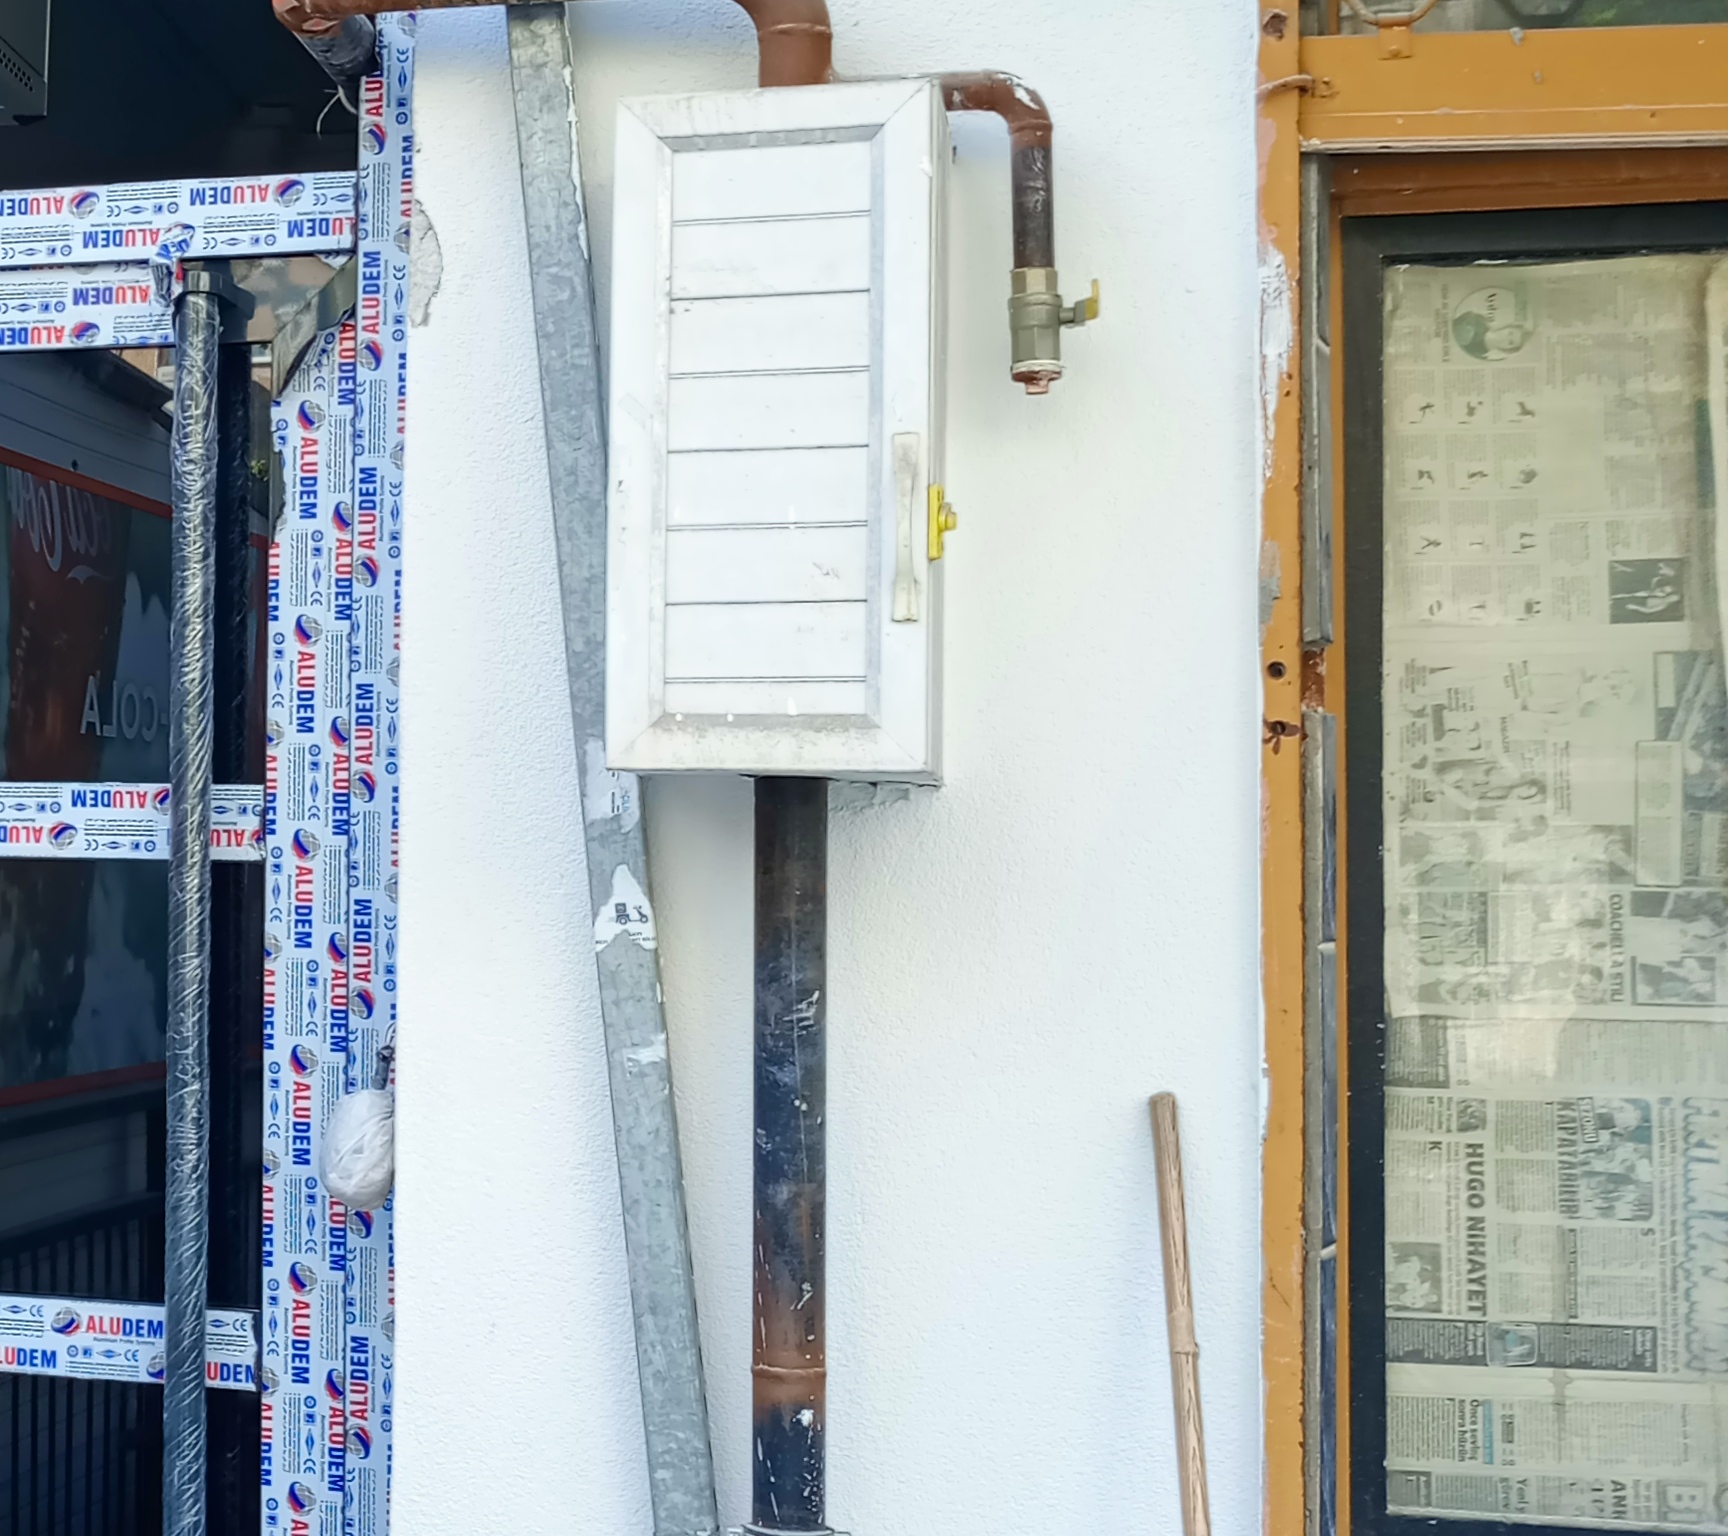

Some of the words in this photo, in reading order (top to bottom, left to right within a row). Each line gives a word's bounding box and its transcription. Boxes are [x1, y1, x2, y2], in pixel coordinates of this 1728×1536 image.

[190, 183, 270, 205] ALUDEM
[82, 227, 160, 248] ALUDEM
[73, 285, 150, 305] ALUDEM
[362, 251, 381, 334] ALUDEM
[337, 322, 355, 405] ALUDEM
[299, 436, 319, 520] ALUDEM
[358, 467, 377, 550] ALUDEM
[333, 538, 352, 621] ALUDEM
[295, 651, 316, 734] ALUDEM
[355, 684, 374, 766] ALUDEM
[71, 789, 148, 809] ALUDEM
[331, 753, 351, 835] ALUDEM
[294, 865, 314, 949] ALUDEM
[353, 899, 372, 983] ALUDEM
[329, 969, 348, 1052] ALUDEM
[292, 1081, 312, 1166] ALUDEM
[1466, 1142, 1485, 1209] HUGO
[1466, 1216, 1487, 1317] NİHAYET
[86, 1314, 164, 1339] ALUDEM
[291, 1299, 311, 1384] ALUDEM
[207, 1360, 257, 1384] UDEM
[350, 1336, 369, 1420] ALUDEM
[327, 1407, 345, 1491] ALUDEM
